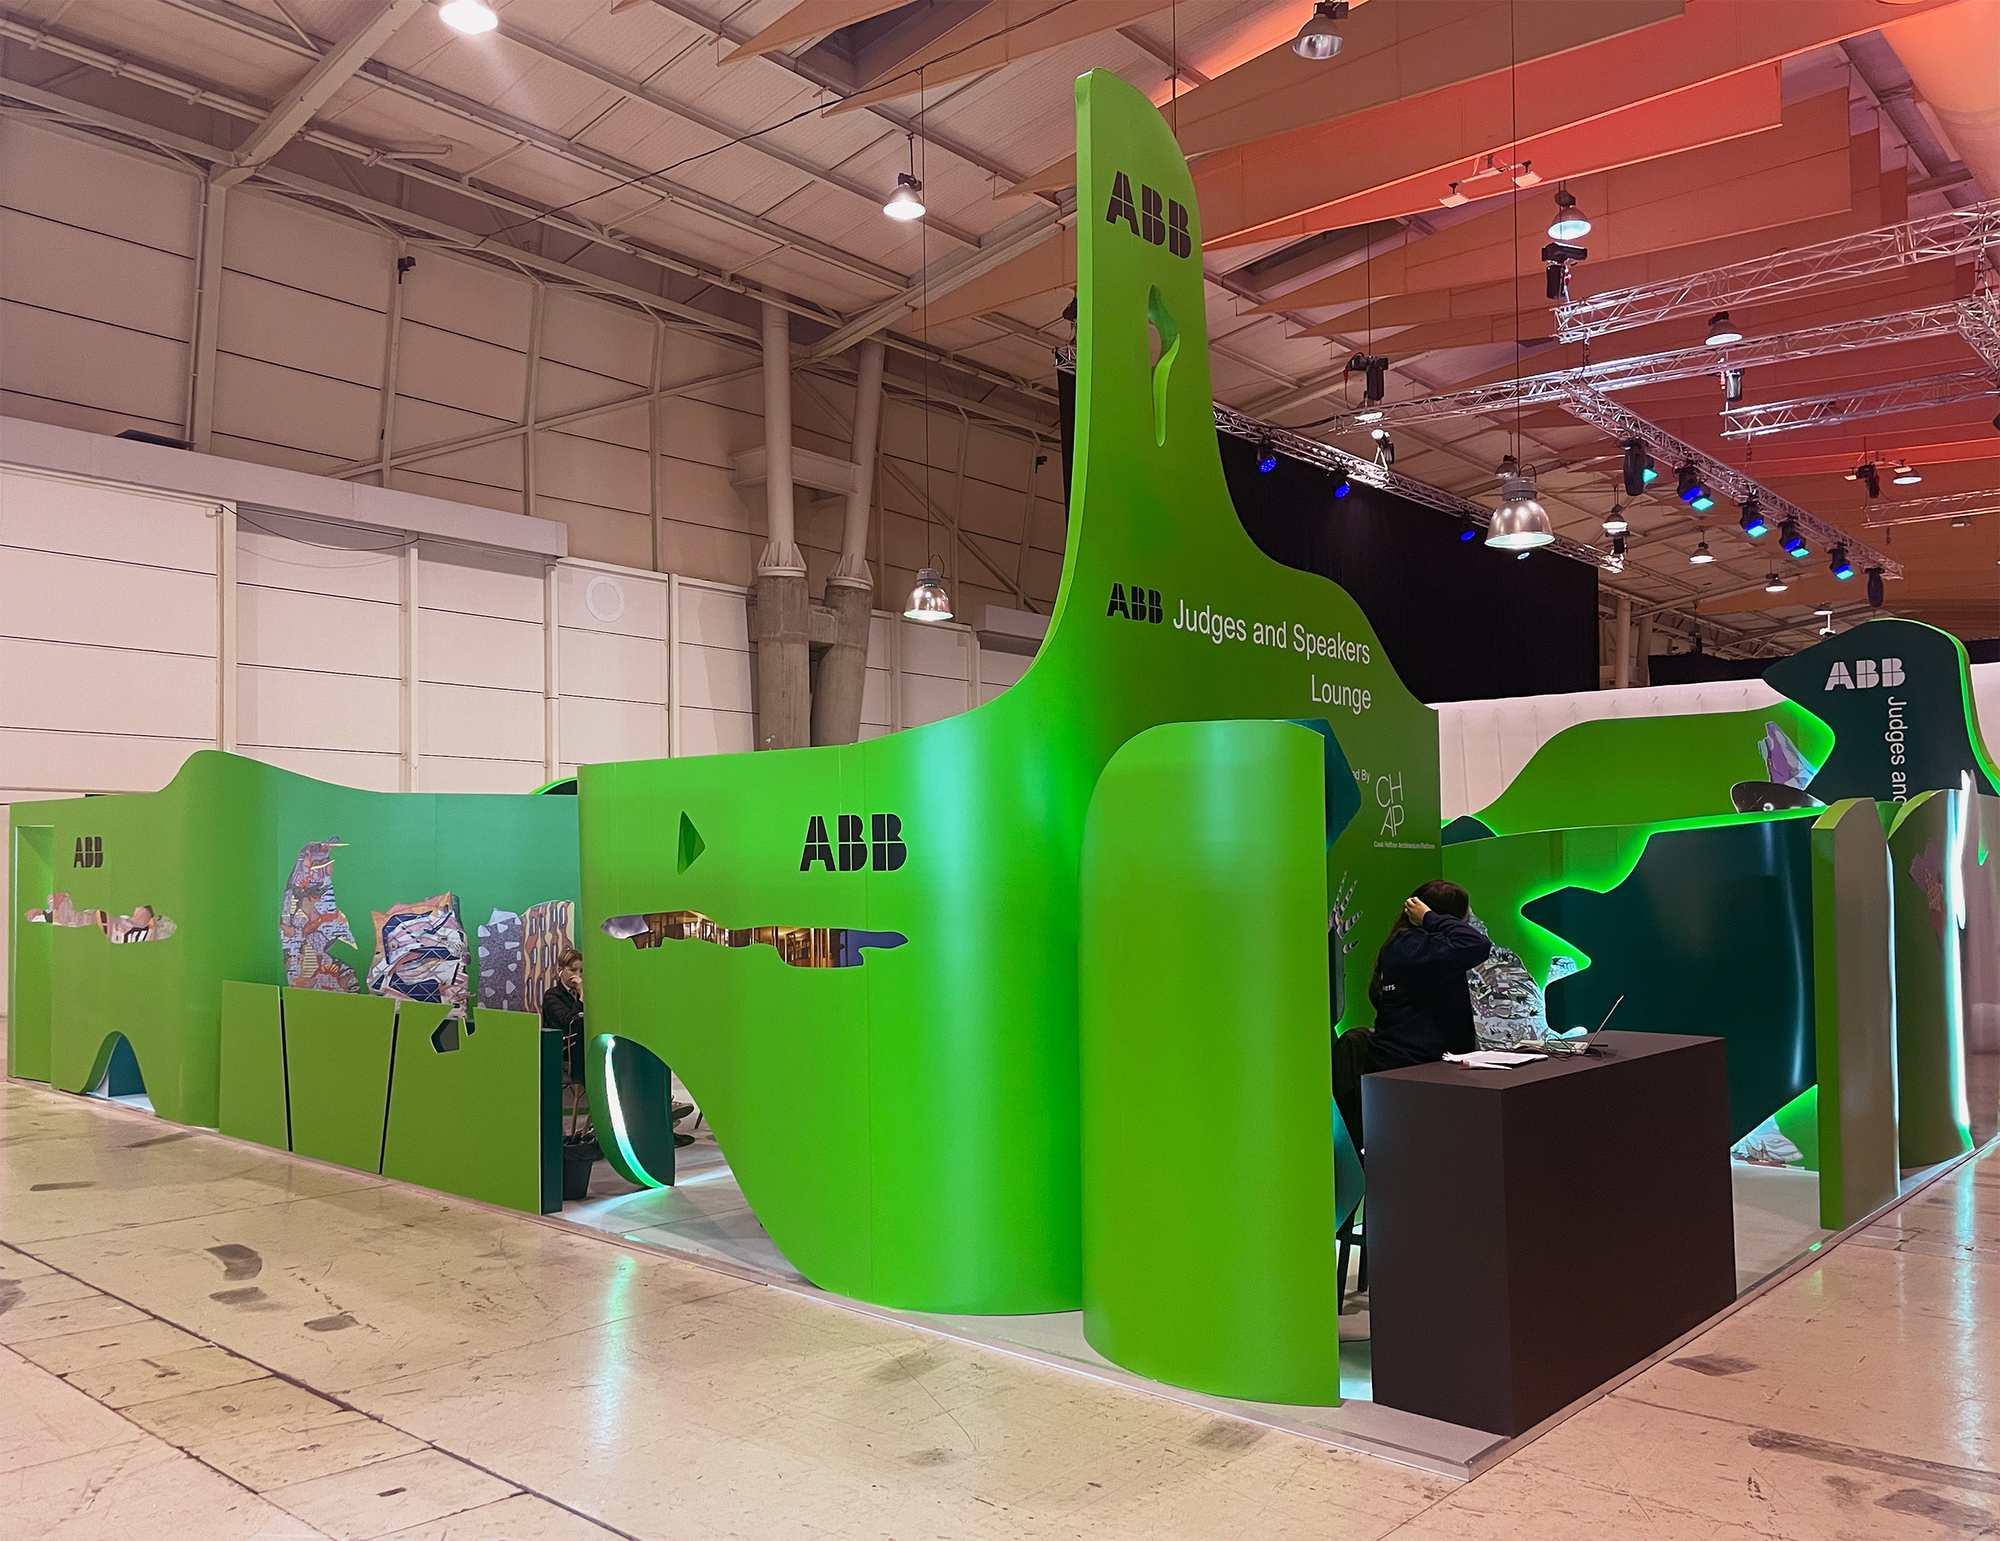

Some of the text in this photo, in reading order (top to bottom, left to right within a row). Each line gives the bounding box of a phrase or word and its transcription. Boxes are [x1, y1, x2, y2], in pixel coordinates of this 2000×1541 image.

[1105, 170, 1192, 259] ABB
[1106, 582, 1371, 665] ABB Judges and Speakers
[1311, 674, 1372, 715] Lounge
[1824, 657, 1906, 691] ABB
[1884, 696, 1909, 766] Judges
[1361, 769, 1371, 784] By
[73, 835, 104, 868] ABB
[799, 813, 908, 872] ABB
